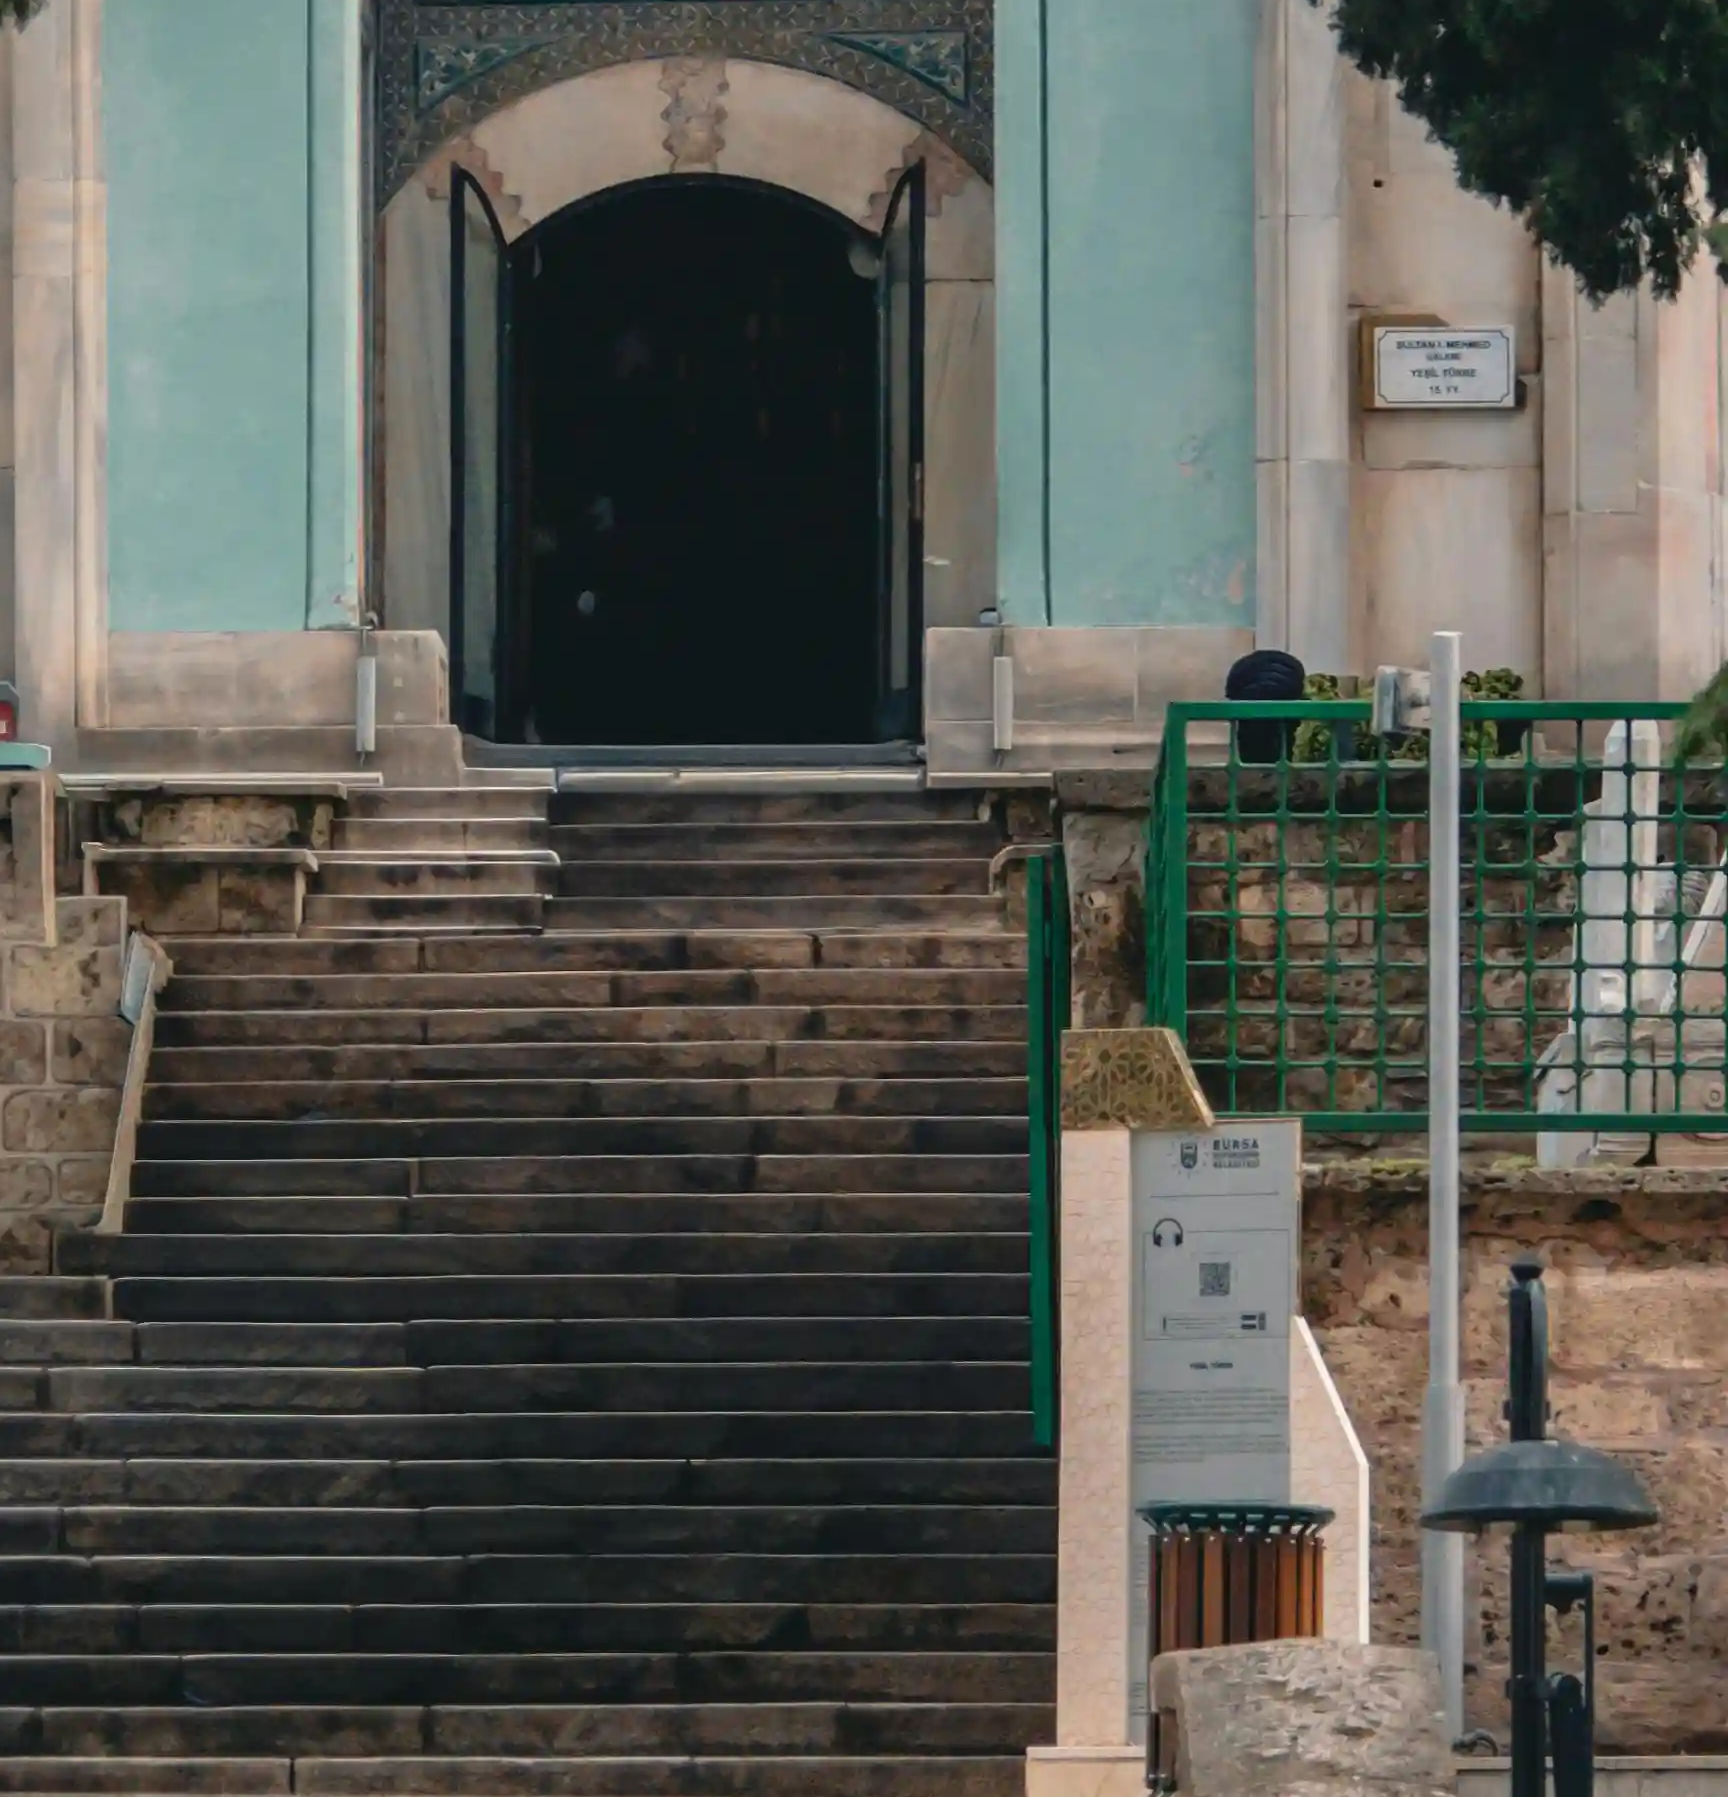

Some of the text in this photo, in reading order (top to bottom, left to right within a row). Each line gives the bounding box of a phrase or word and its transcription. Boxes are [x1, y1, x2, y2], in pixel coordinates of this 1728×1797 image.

[1396, 340, 1435, 350] SULTAN
[1446, 340, 1491, 350] MEHMED
[1213, 1138, 1259, 1151] BURSA
